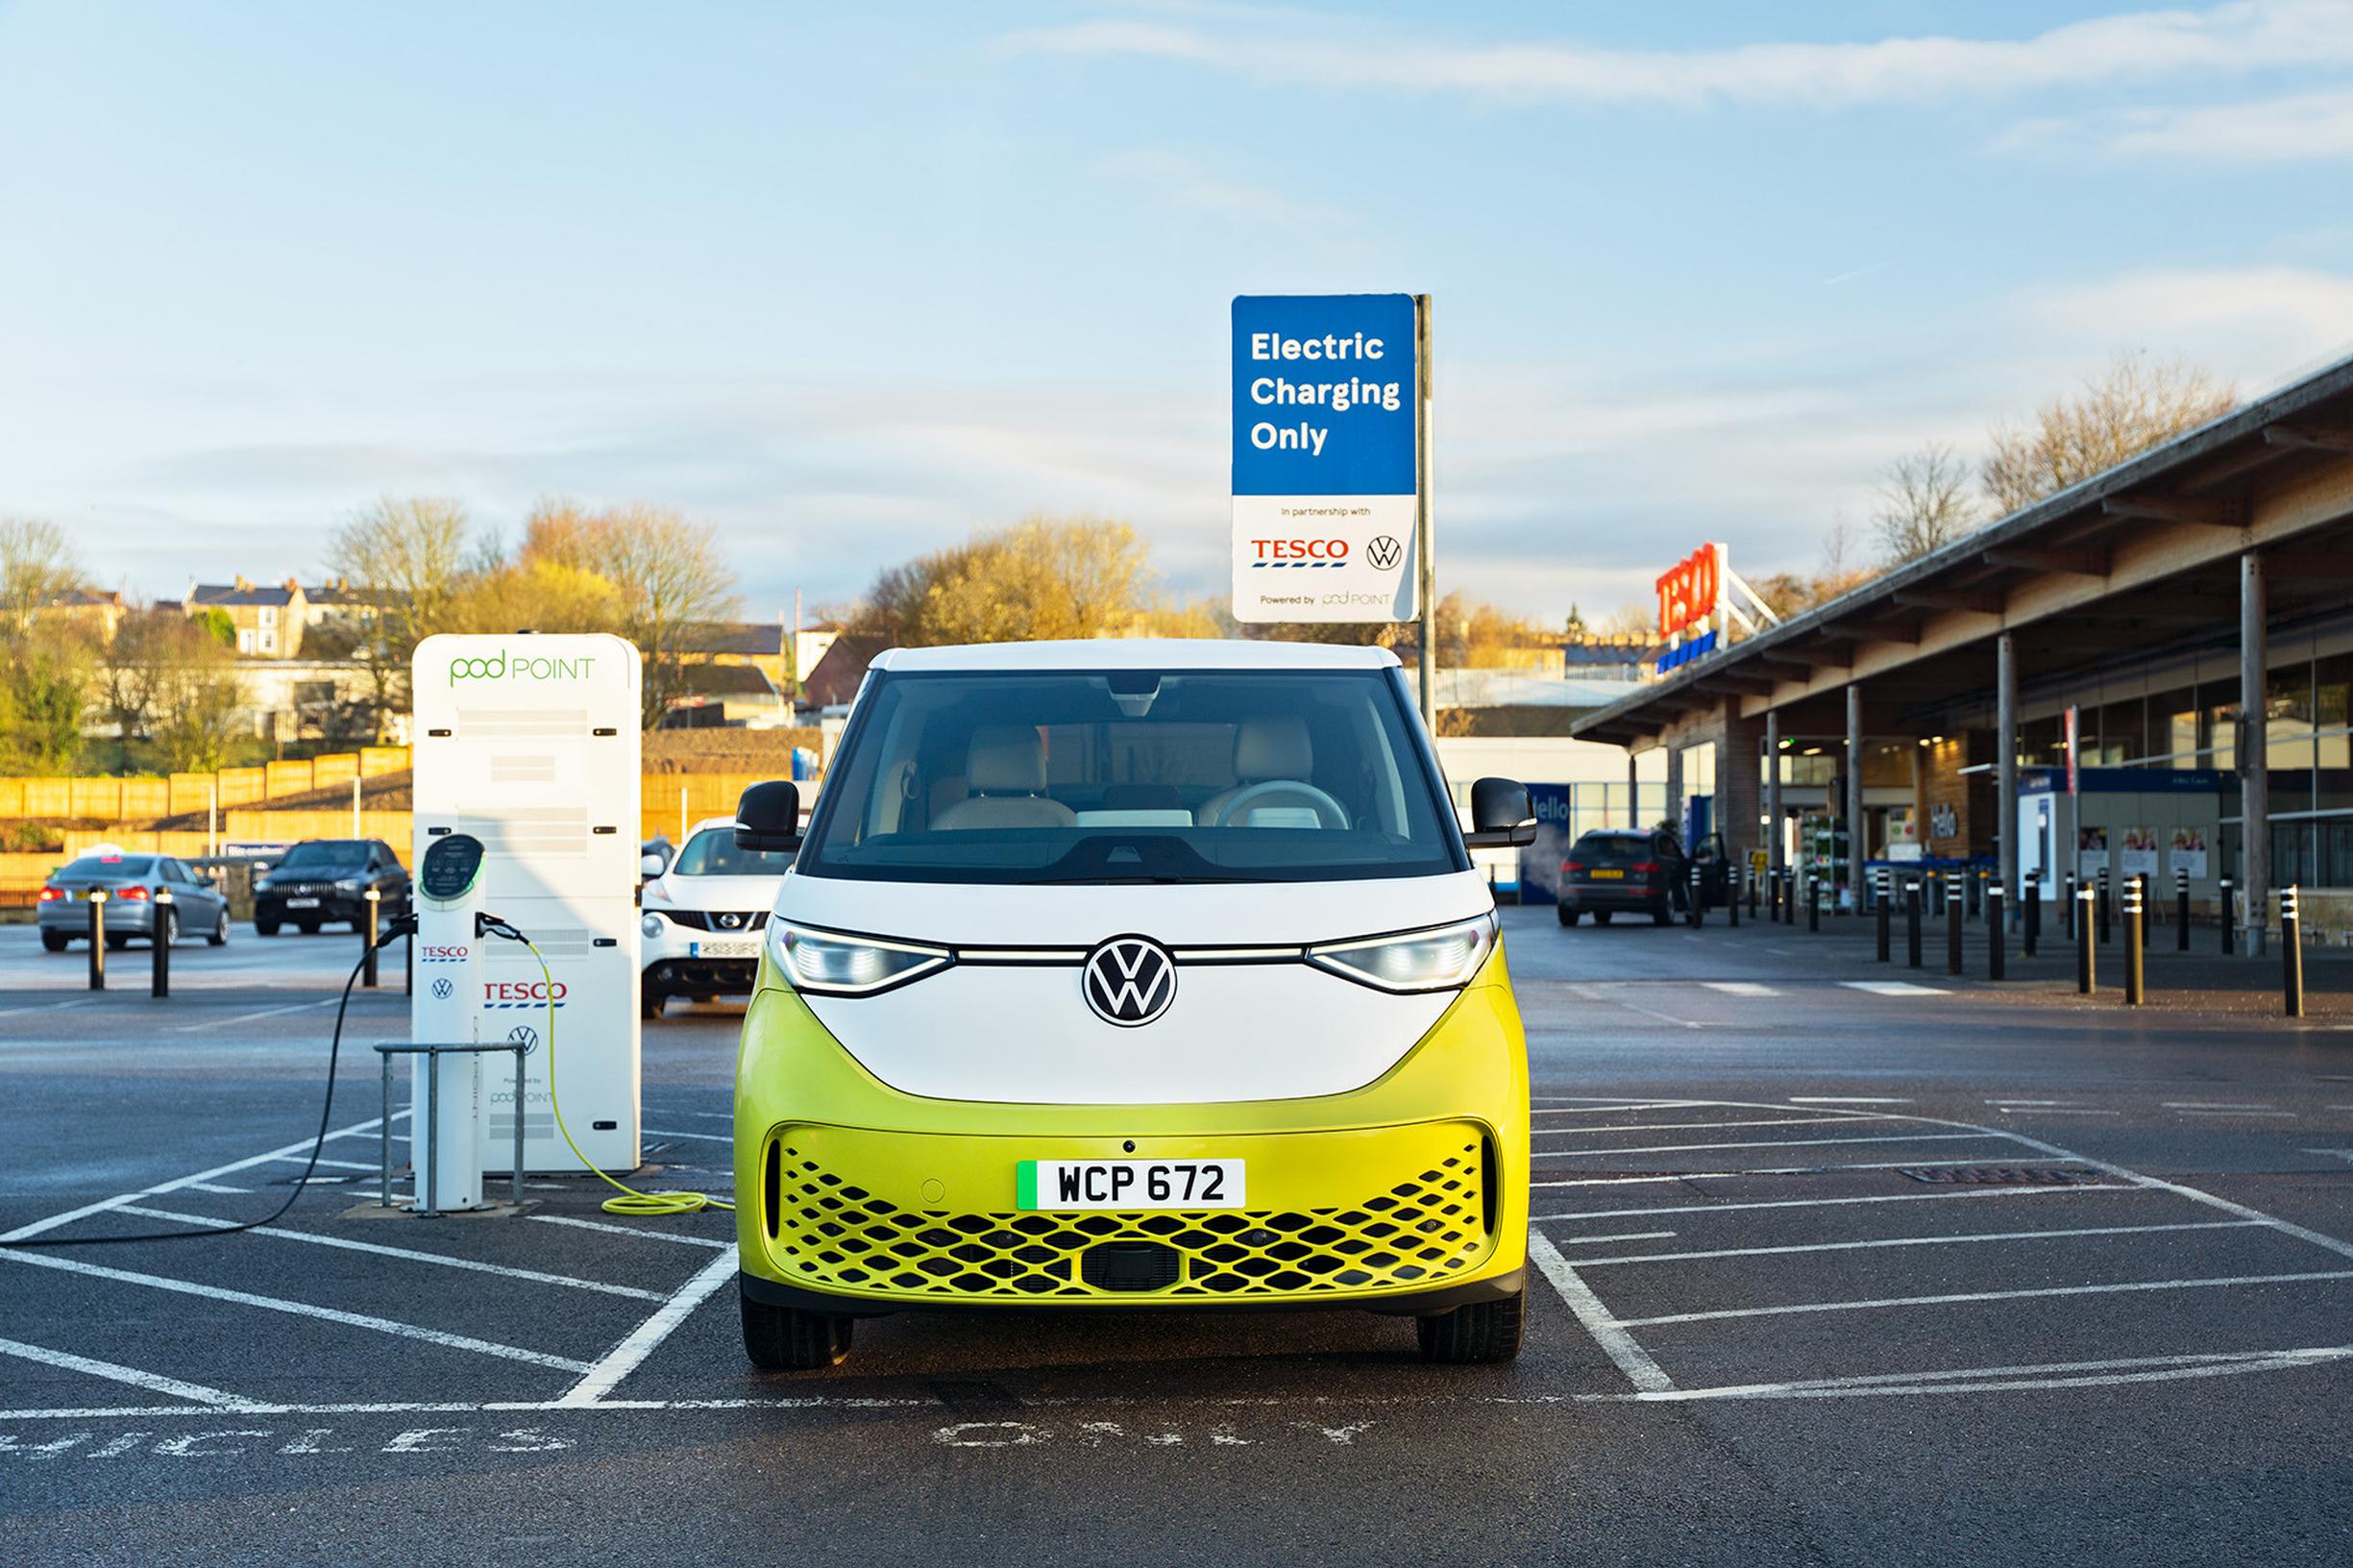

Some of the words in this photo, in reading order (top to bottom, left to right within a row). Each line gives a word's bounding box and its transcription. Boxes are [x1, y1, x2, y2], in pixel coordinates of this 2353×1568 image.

[1252, 331, 1385, 360] Electric
[1251, 377, 1400, 411] Charging
[1251, 422, 1328, 456] Only
[1281, 507, 1289, 516] In
[1292, 507, 1348, 517] partnership
[1351, 507, 1371, 516] with
[1251, 539, 1349, 558] TESCO
[1261, 595, 1301, 604] Powered
[1304, 595, 1315, 605] by
[1353, 594, 1390, 605] POINT
[450, 648, 505, 688] pod
[512, 657, 596, 679] POINT
[1532, 796, 1569, 820] ello
[422, 946, 468, 958] TESCO
[484, 982, 567, 1000] TESCO
[1058, 1165, 1135, 1202] WCP
[1147, 1164, 1224, 1201] 672
